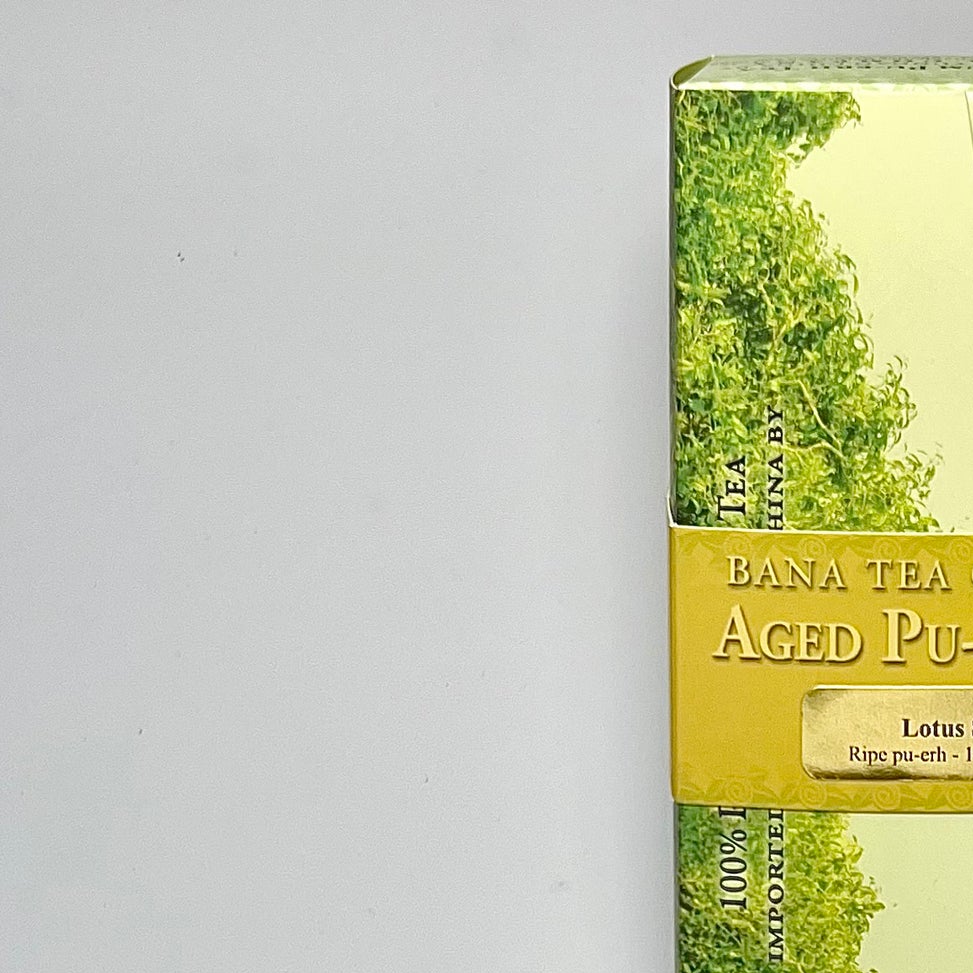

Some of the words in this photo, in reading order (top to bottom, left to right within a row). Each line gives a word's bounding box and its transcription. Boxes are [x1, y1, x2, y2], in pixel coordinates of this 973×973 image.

[767, 404, 784, 445] BY
[717, 455, 746, 521] TEA
[767, 453, 784, 530] HINA
[726, 555, 847, 589] BANA
[866, 559, 951, 591] TEA
[712, 602, 864, 664] AGED
[902, 718, 964, 738] Lotus
[849, 745, 888, 765] Ripe
[892, 745, 946, 766] pu-erh
[719, 829, 748, 910] 100%
